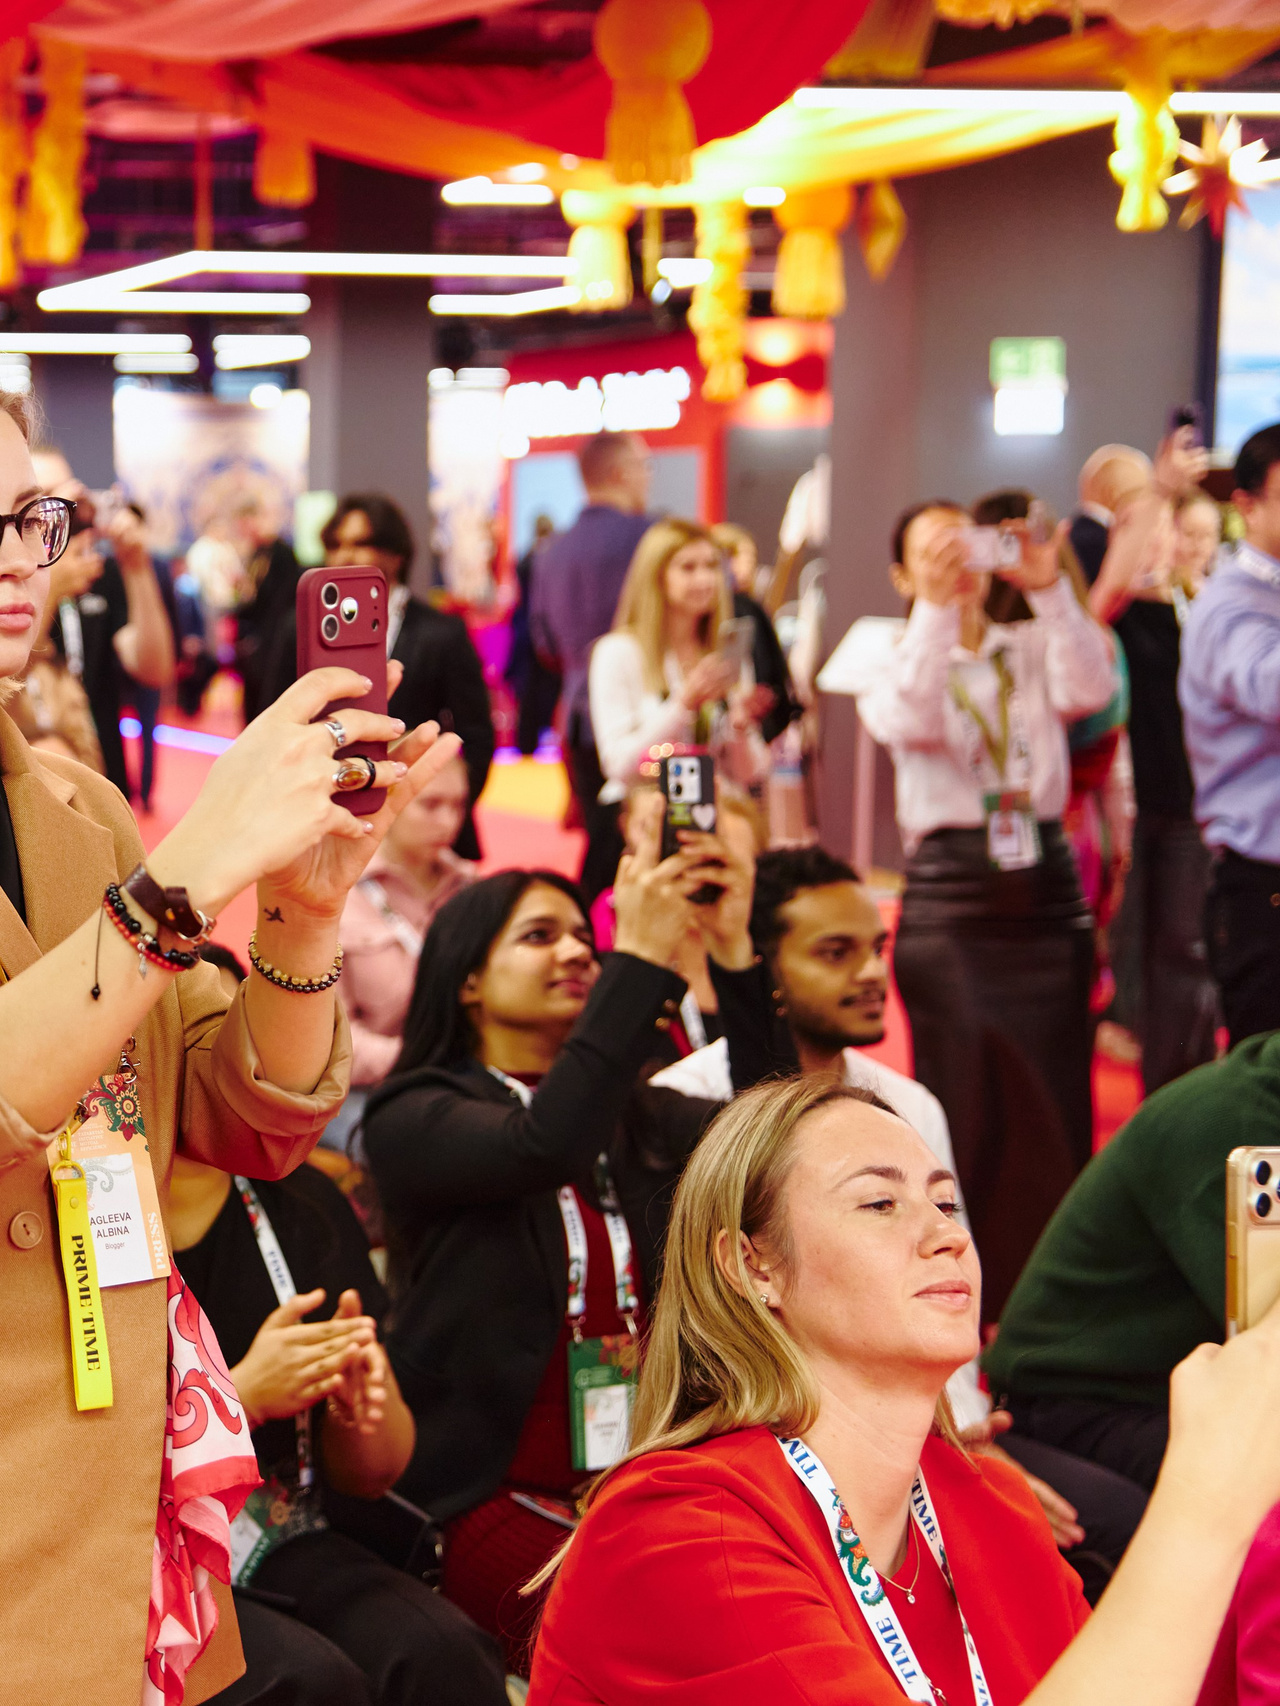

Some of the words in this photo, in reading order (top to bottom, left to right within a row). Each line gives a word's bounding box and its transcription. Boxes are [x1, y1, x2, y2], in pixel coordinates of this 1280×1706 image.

[89, 1212, 132, 1226] AGLEEVA
[96, 1226, 130, 1239] ALBINA
[148, 1212, 166, 1270] PRESS
[105, 1242, 126, 1250] Blogger
[71, 1235, 92, 1308] PRIME
[82, 1311, 101, 1371] TIME
[779, 1437, 818, 1479] TIM
[911, 1478, 938, 1542] TIME
[875, 1616, 918, 1684] TIME
